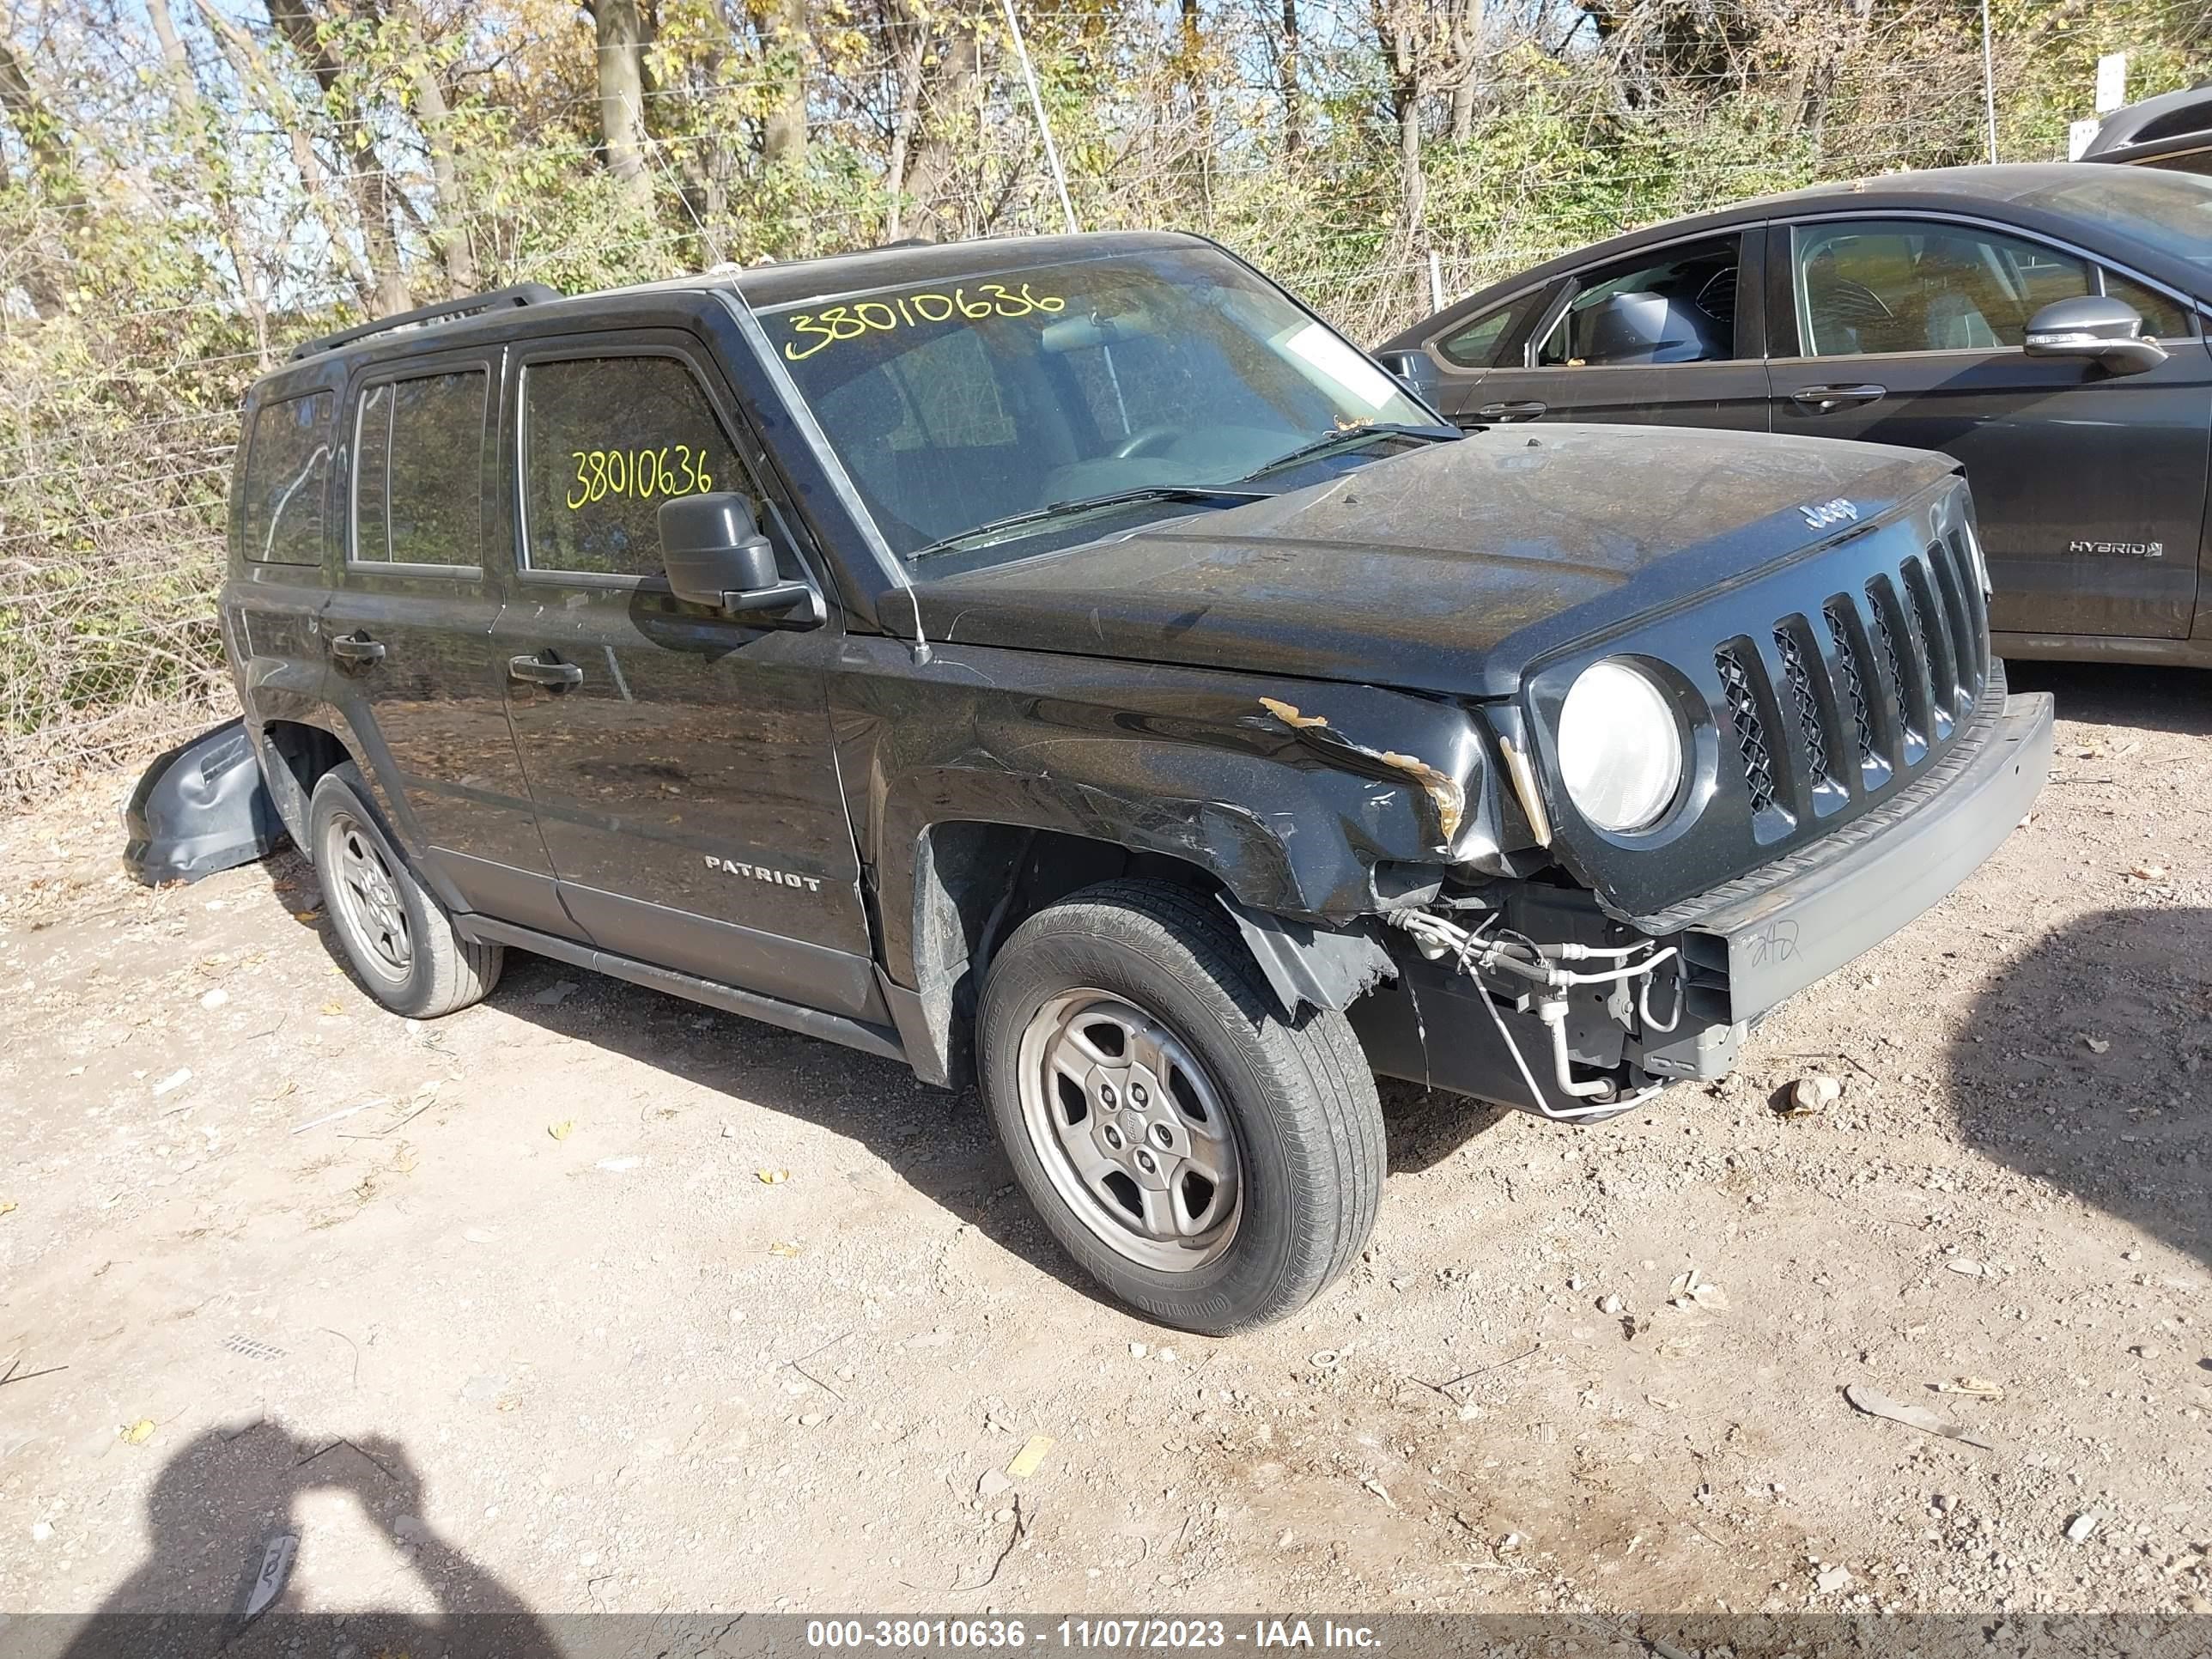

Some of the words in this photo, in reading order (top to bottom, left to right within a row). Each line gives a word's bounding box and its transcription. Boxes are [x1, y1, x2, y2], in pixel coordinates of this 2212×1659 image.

[785, 283, 1065, 361] 38010636
[567, 445, 712, 510] 38010636
[1799, 497, 1858, 531] Jeep
[2069, 541, 2145, 555] HYBRID
[704, 854, 821, 892] PATRIOT
